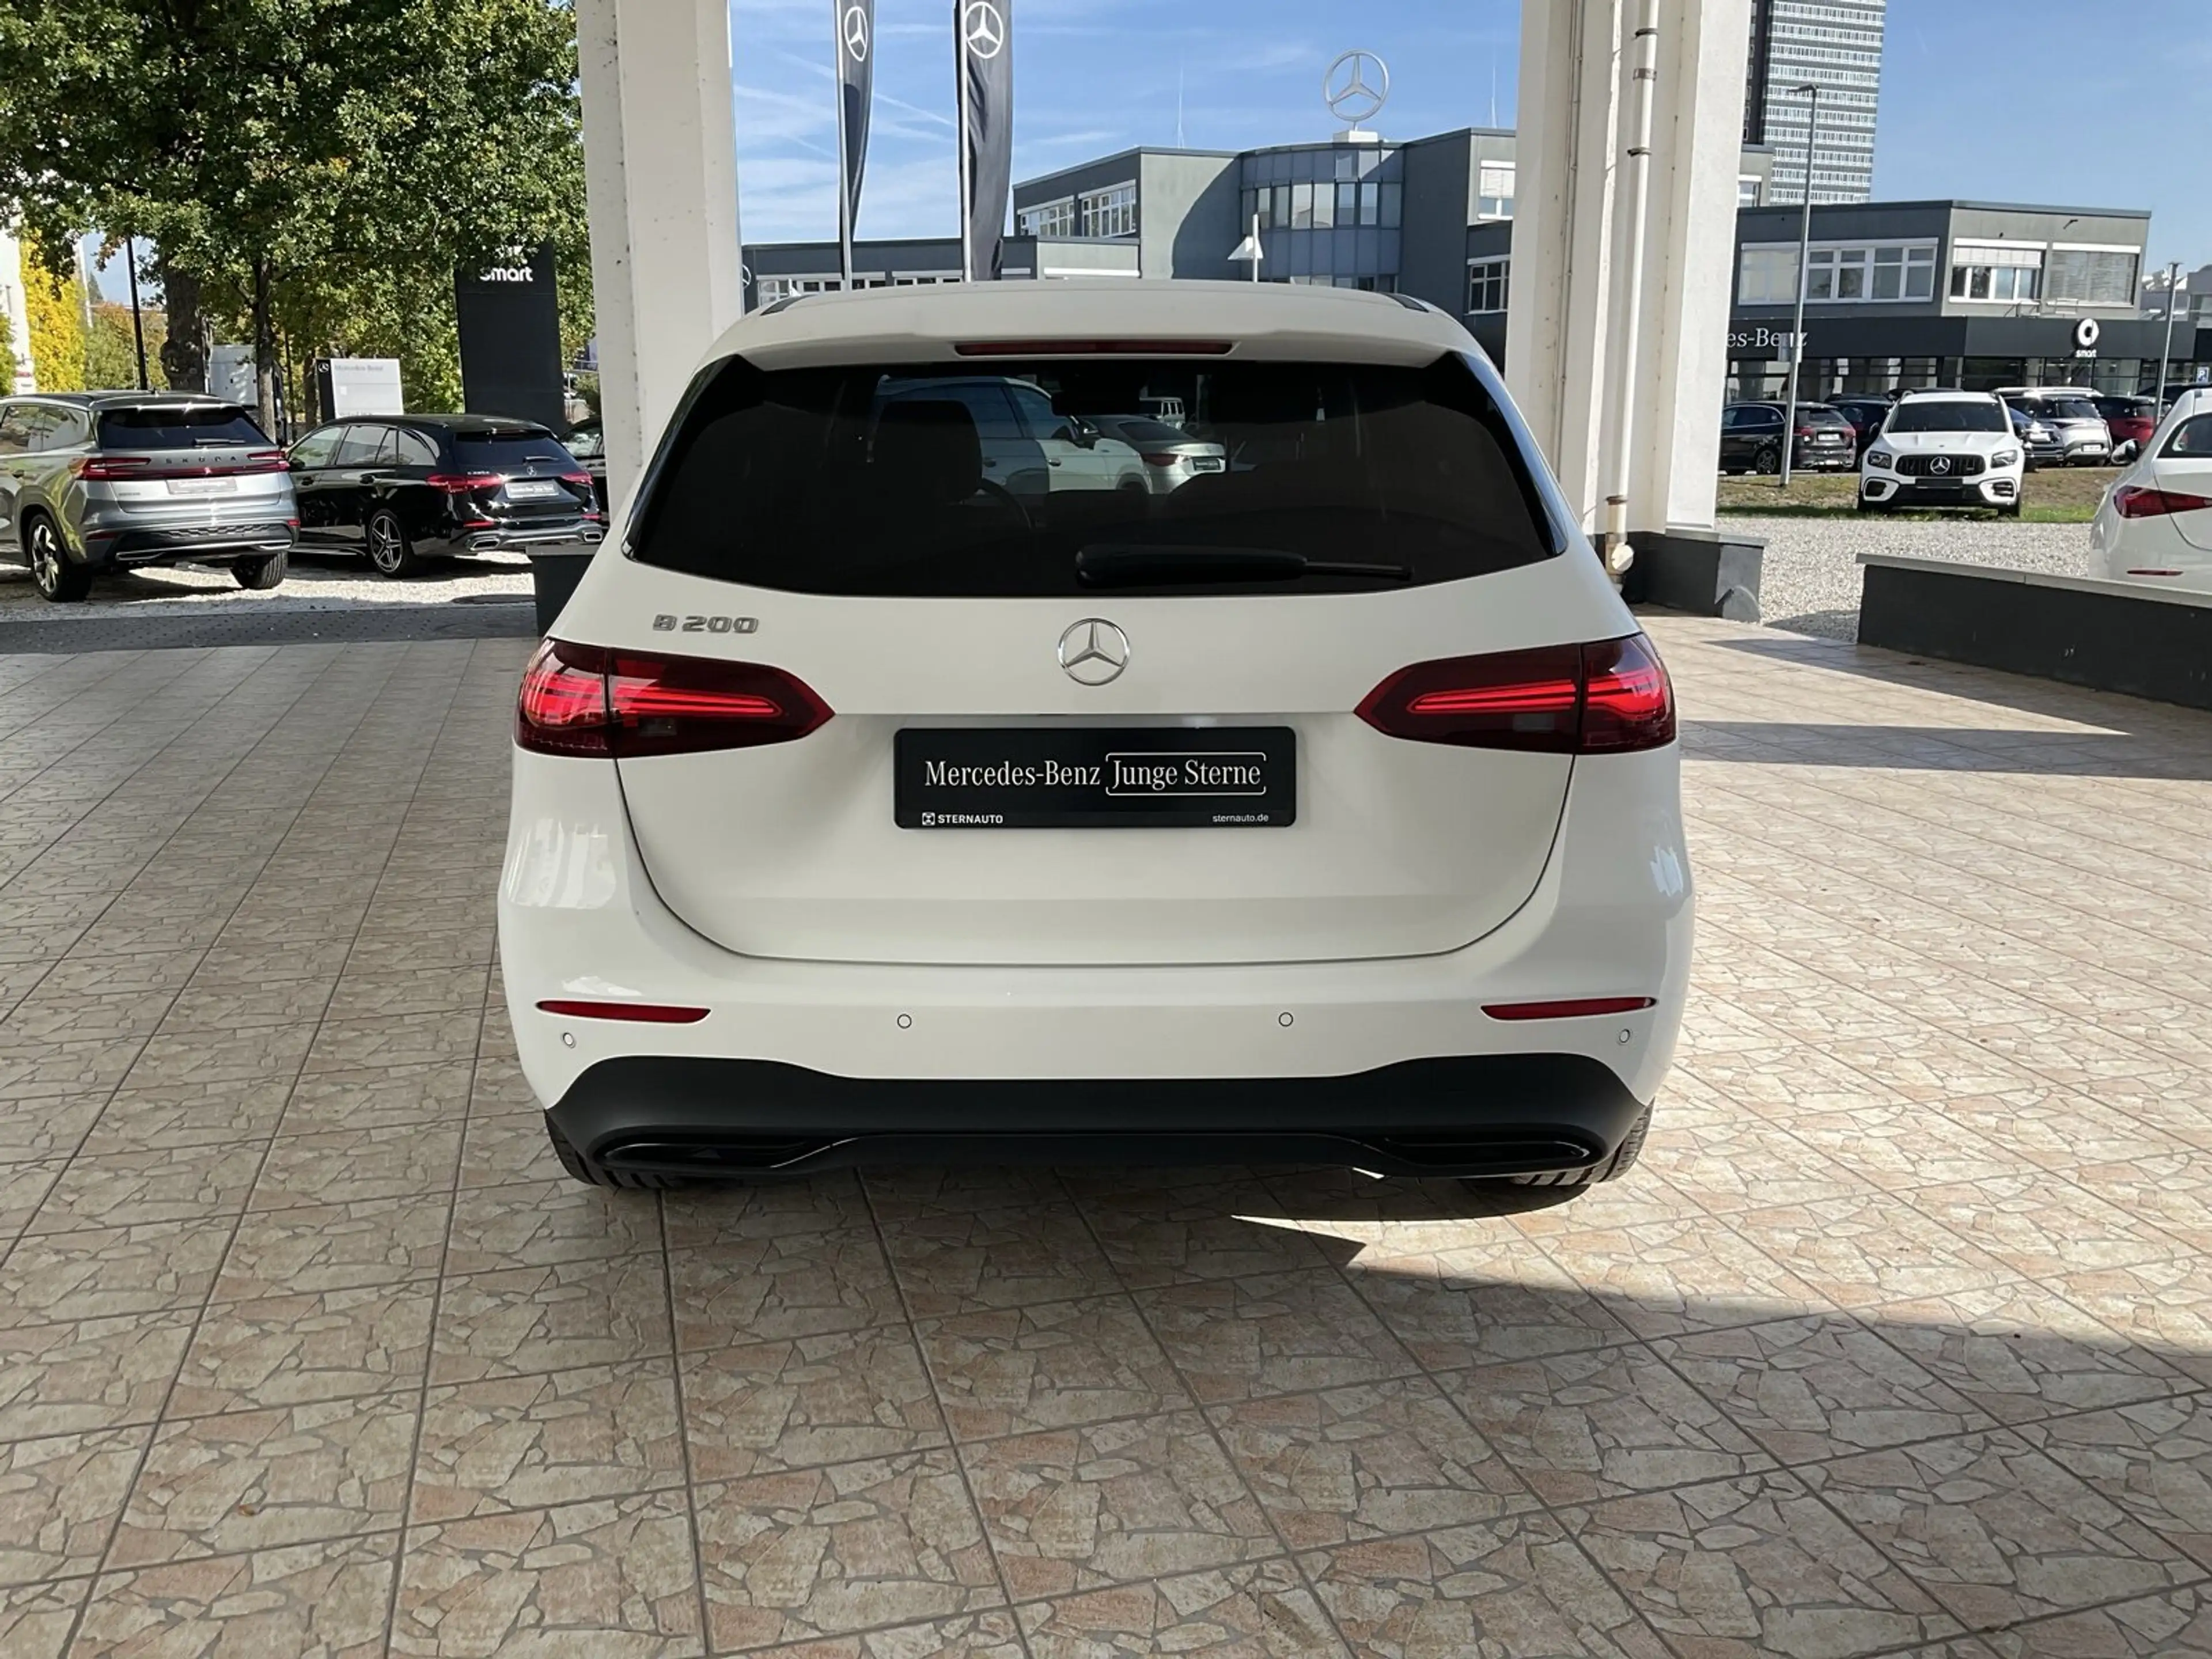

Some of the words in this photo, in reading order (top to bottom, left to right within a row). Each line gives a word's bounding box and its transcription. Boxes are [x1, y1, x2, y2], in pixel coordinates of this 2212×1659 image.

[653, 615, 677, 631] B
[682, 616, 759, 634] 200
[925, 760, 1101, 786] Mercedes-Benz
[1112, 760, 1178, 791] Junge
[1184, 759, 1260, 785] Sterne
[937, 814, 1003, 824] STERNAUTO
[1212, 813, 1269, 823] sternauto.de
